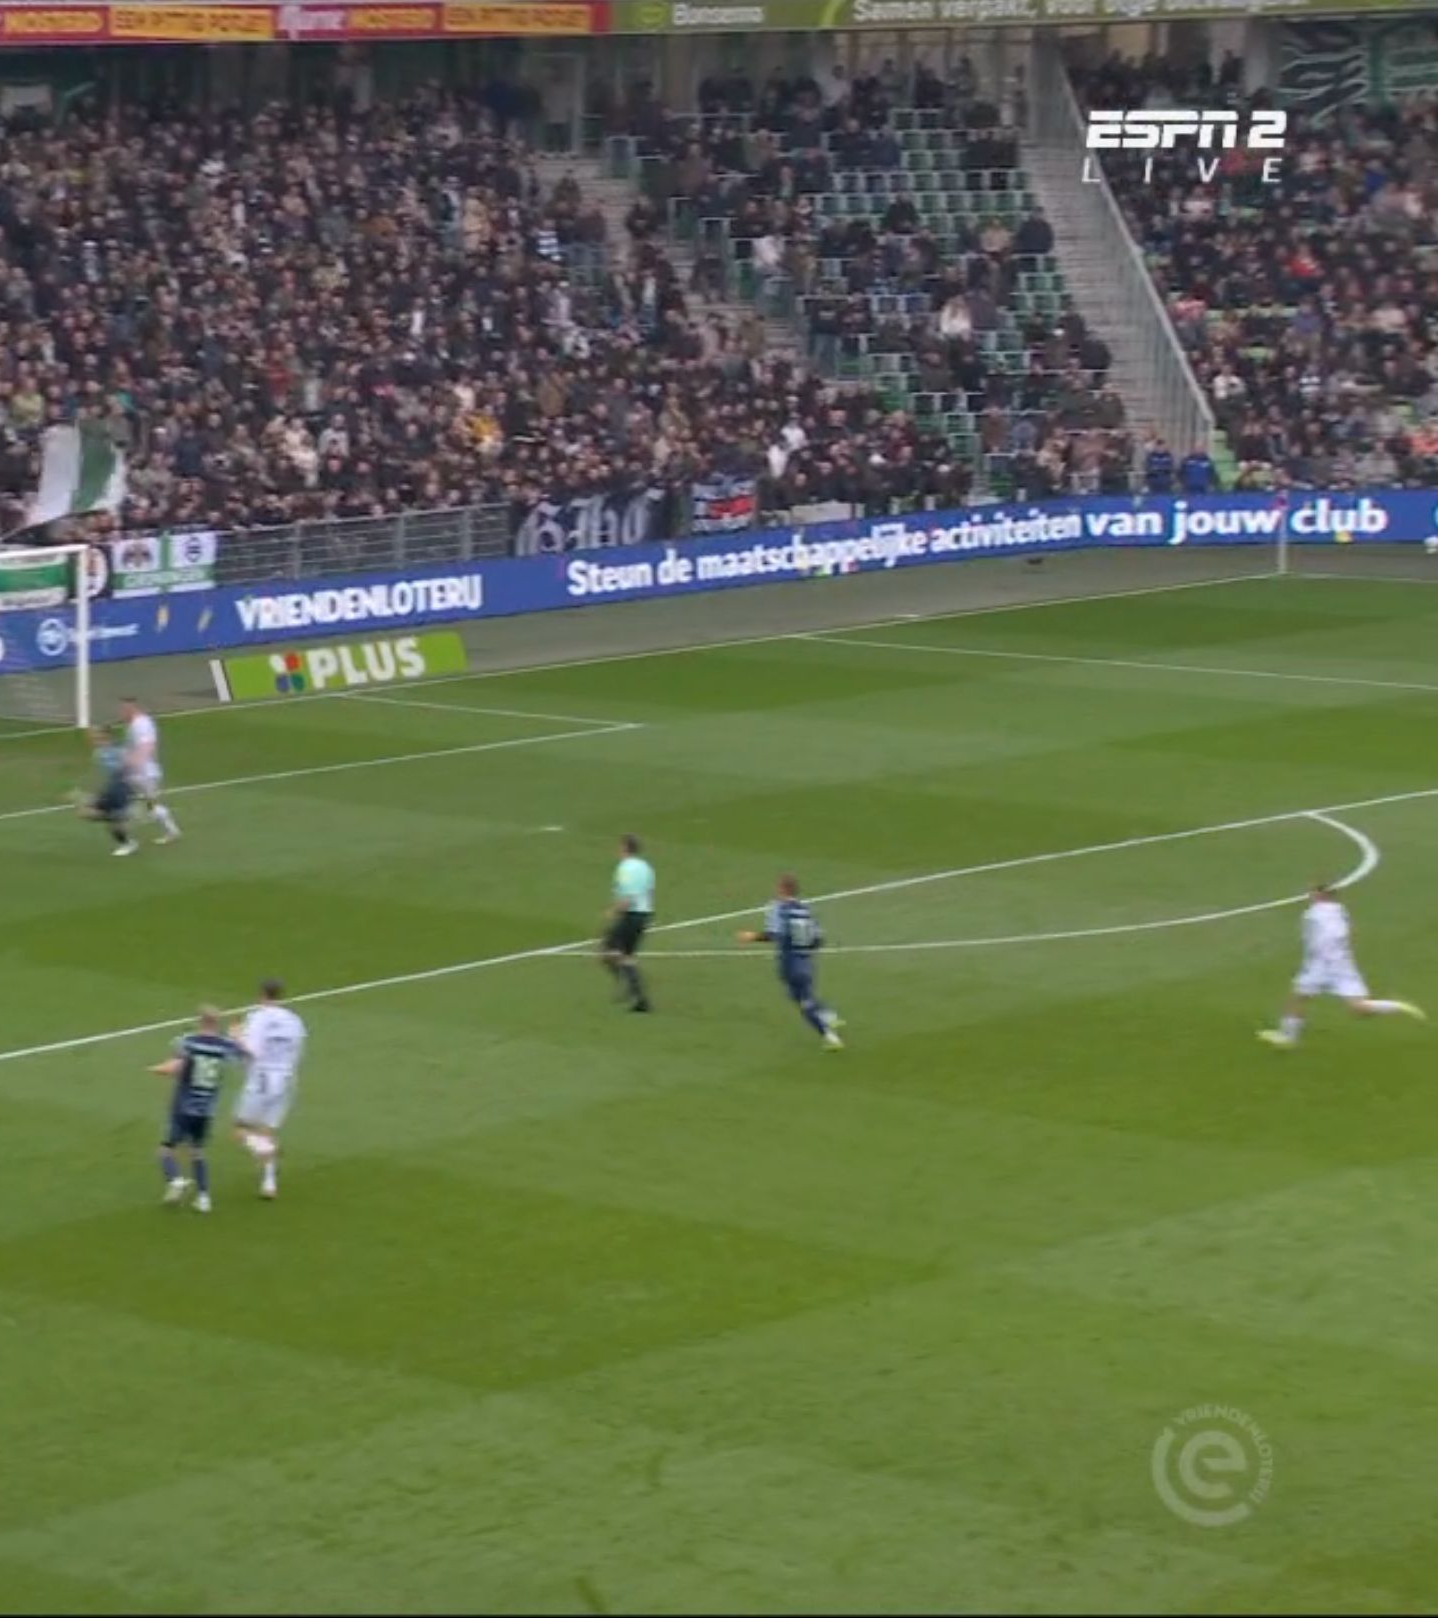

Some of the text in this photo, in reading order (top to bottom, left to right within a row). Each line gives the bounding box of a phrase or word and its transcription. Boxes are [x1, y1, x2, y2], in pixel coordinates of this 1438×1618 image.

[567, 498, 1389, 597] Steun de maatschappelijke activiteiten van jouw club
[235, 573, 484, 632] VRIENDENLOTERIJ
[306, 636, 427, 690] PLUS
